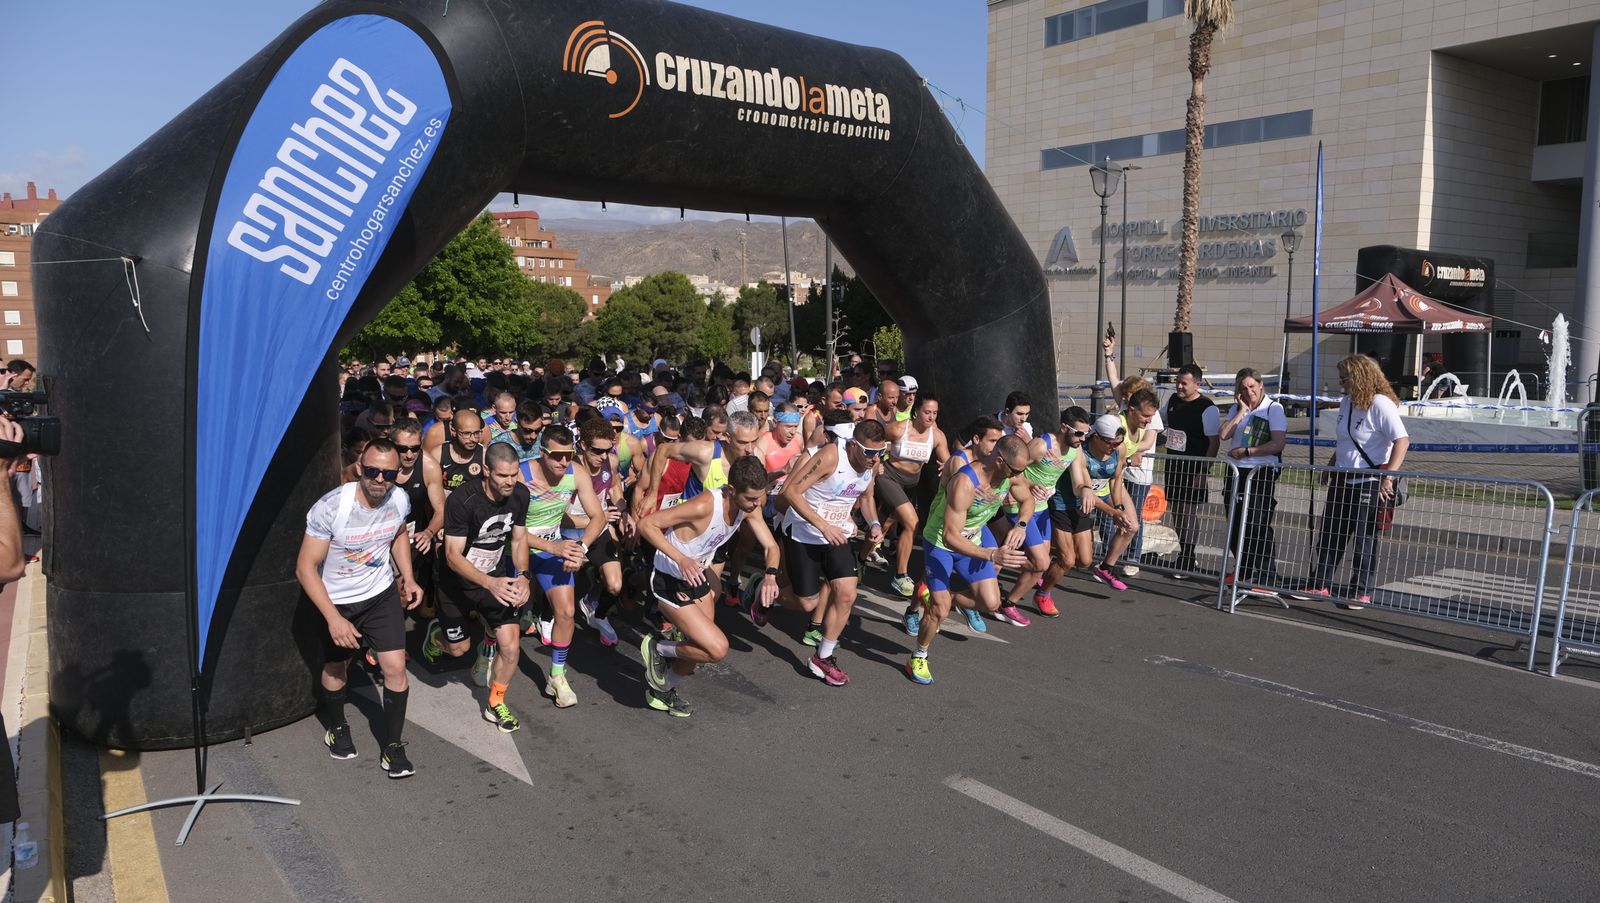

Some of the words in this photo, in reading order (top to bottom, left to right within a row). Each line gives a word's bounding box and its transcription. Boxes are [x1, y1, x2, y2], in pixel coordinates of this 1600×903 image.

[655, 52, 891, 124] cruzandolameta
[737, 108, 830, 133] cronometraje
[832, 120, 891, 141] deportivo
[326, 117, 443, 301] centrohogarsanchez.es
[1190, 208, 1307, 233] IVERSITARIO
[1123, 239, 1276, 263] TORRERDENAS
[905, 448, 928, 458] 1089
[823, 511, 848, 521] 1099
